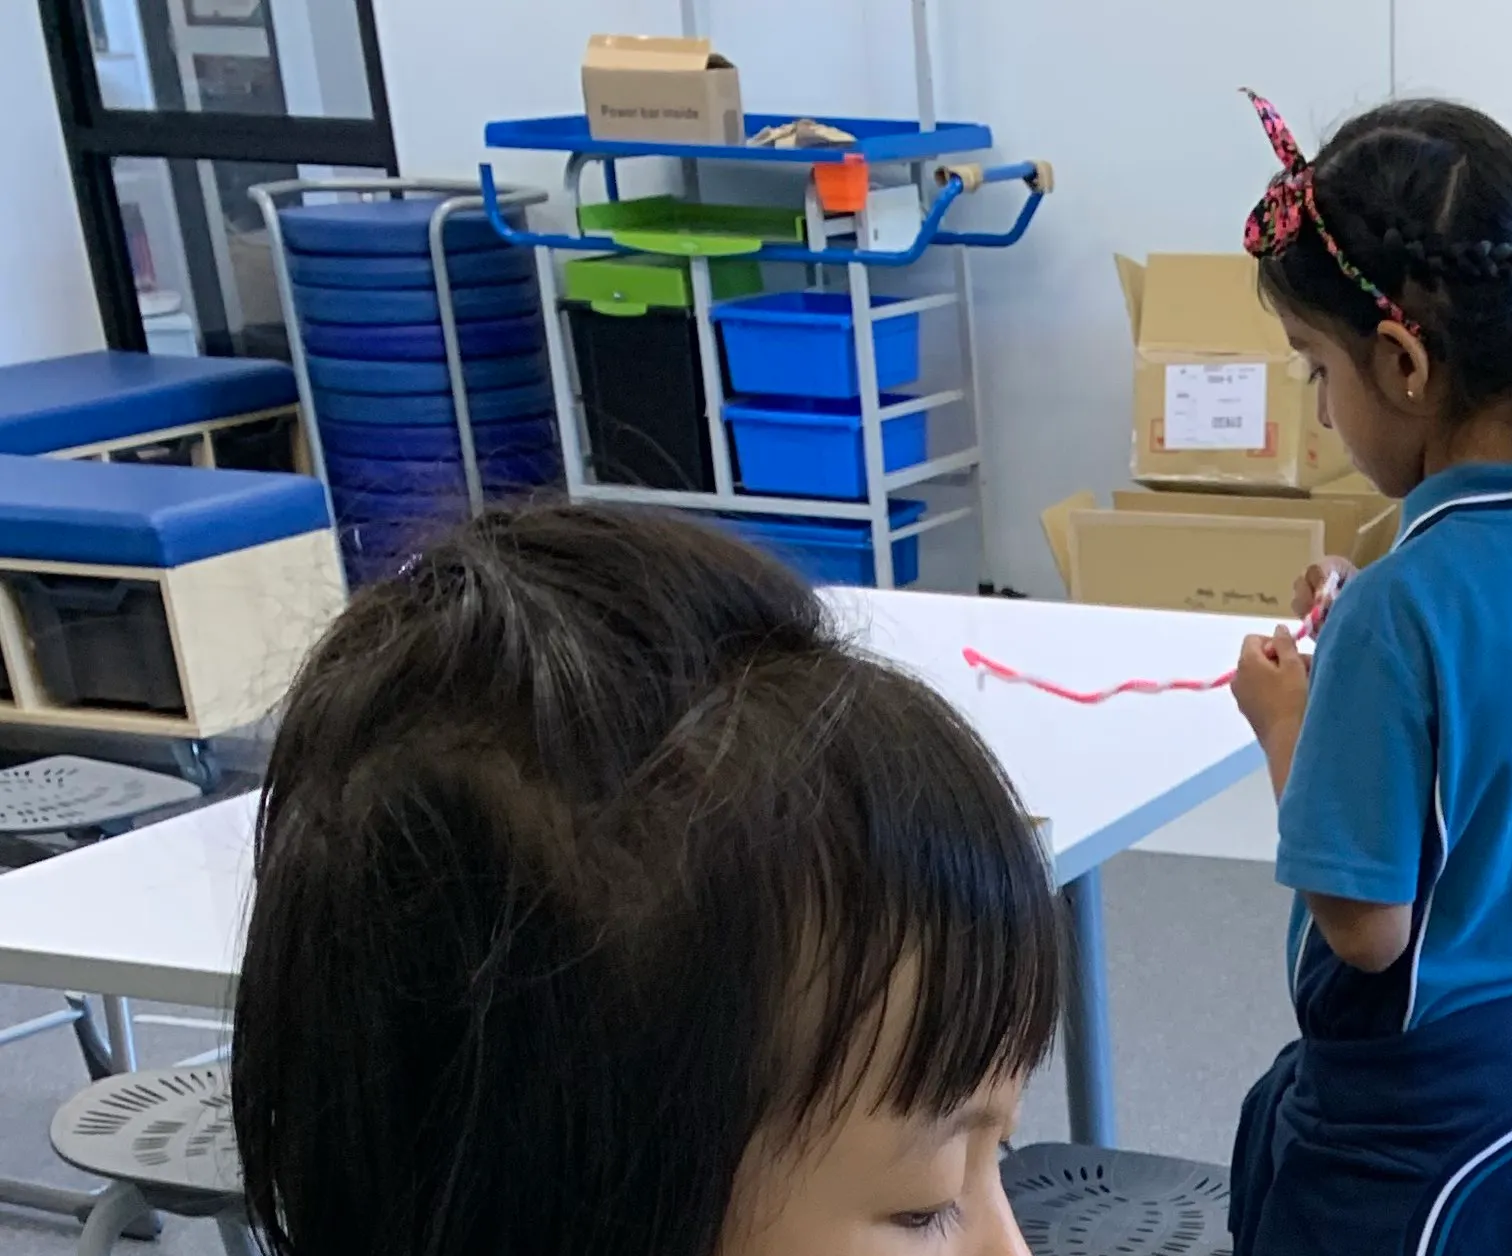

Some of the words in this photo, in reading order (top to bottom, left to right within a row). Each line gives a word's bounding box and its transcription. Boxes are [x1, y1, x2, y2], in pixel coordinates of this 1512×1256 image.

[600, 104, 638, 119] Power
[640, 107, 660, 119] bar
[662, 107, 699, 120] inside
